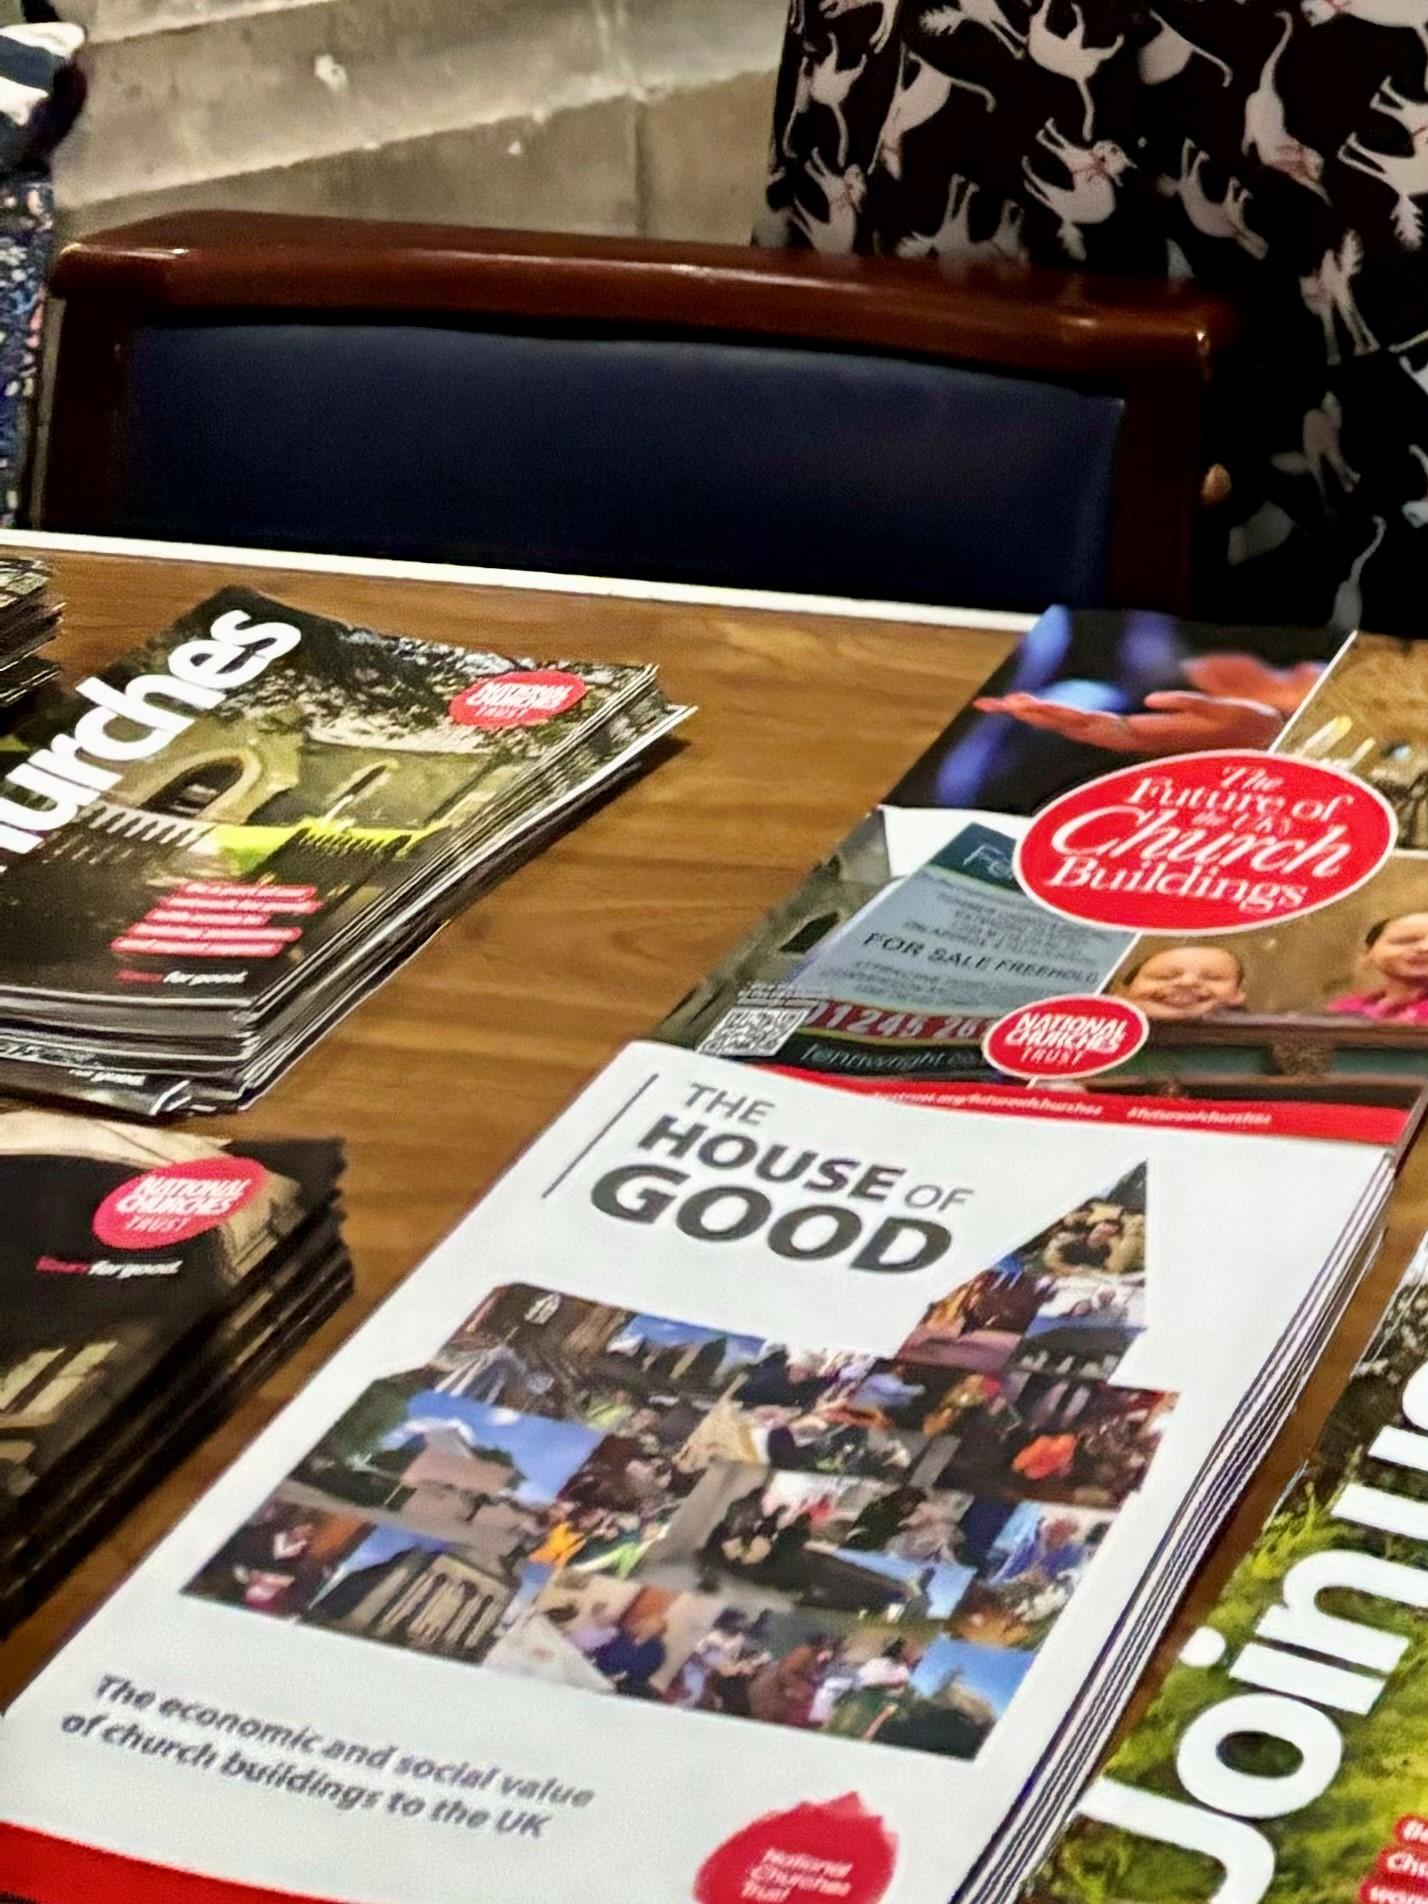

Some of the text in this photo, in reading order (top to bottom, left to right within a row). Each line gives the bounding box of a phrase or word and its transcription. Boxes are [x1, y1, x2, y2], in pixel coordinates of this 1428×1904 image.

[1126, 776, 1355, 823] Future of
[1221, 765, 1285, 791] The
[1051, 805, 1352, 879] Church
[1044, 855, 1309, 915] Buildings
[863, 932, 1101, 983] FOR SALE FREEHOLD
[1005, 1027, 1128, 1054] CHURCHES
[1015, 1012, 1126, 1035] NATIONAL
[1020, 1046, 1087, 1067] TRUST
[681, 1081, 776, 1127] THE
[637, 1114, 975, 1212] HOUSE OF
[115, 1192, 234, 1217] CHURCHES
[132, 1174, 252, 1199] NATIONAL
[124, 1214, 191, 1233] TRUST
[590, 1163, 953, 1275] GOOD
[95, 1673, 597, 1809] The economic and social value
[61, 1711, 553, 1840] of church buildings to the UK
